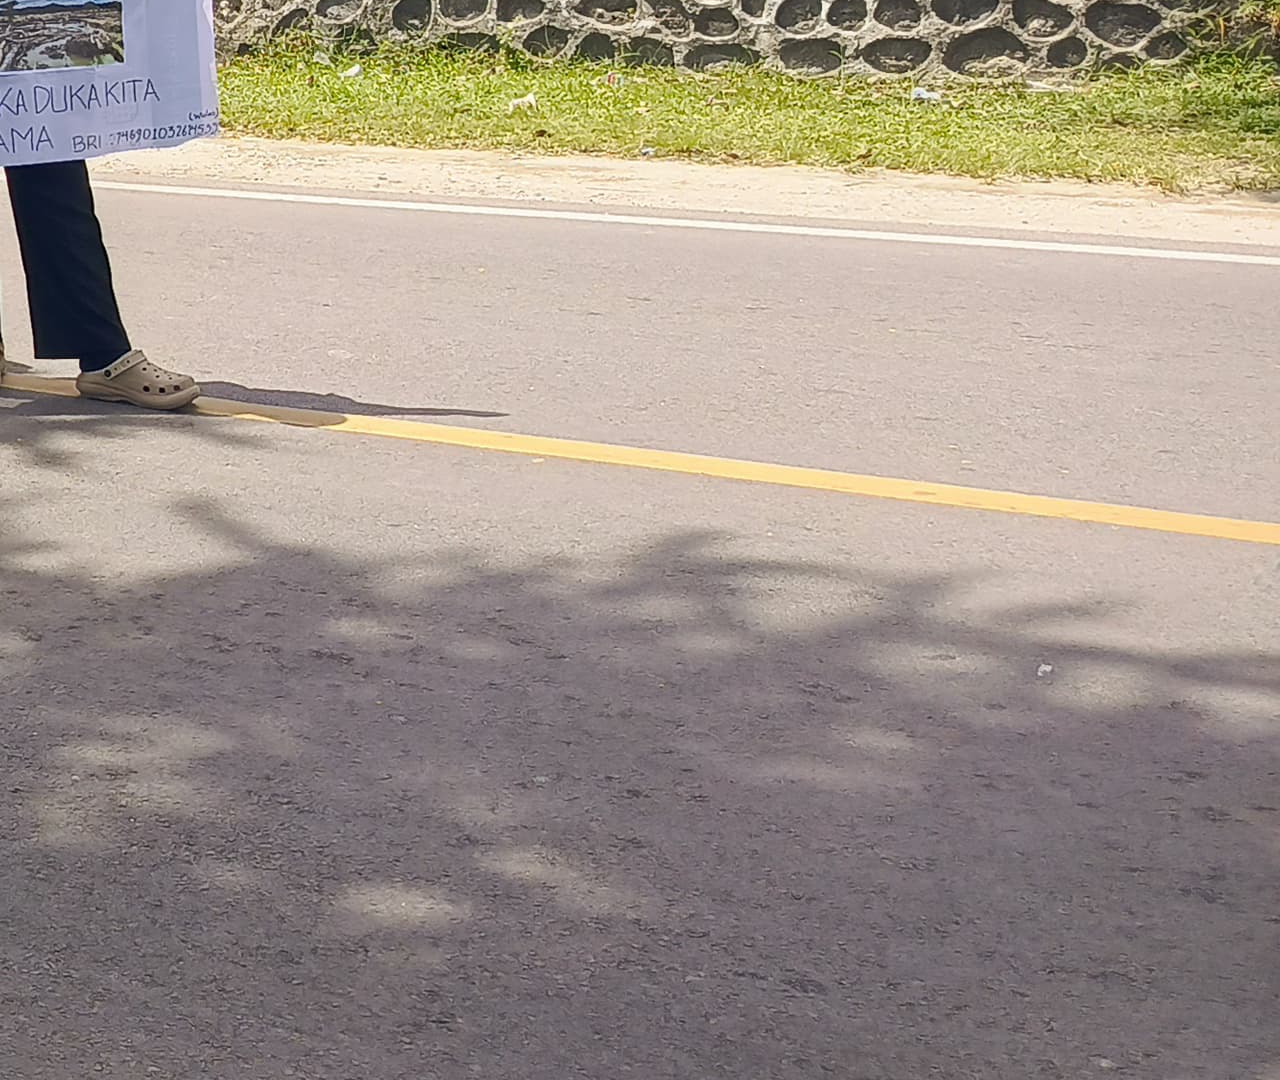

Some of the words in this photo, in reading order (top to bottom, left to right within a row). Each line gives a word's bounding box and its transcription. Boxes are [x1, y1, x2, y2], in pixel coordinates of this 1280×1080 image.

[33, 83, 102, 114] DUKA
[104, 78, 161, 107] KITA
[72, 134, 102, 153] BRI
